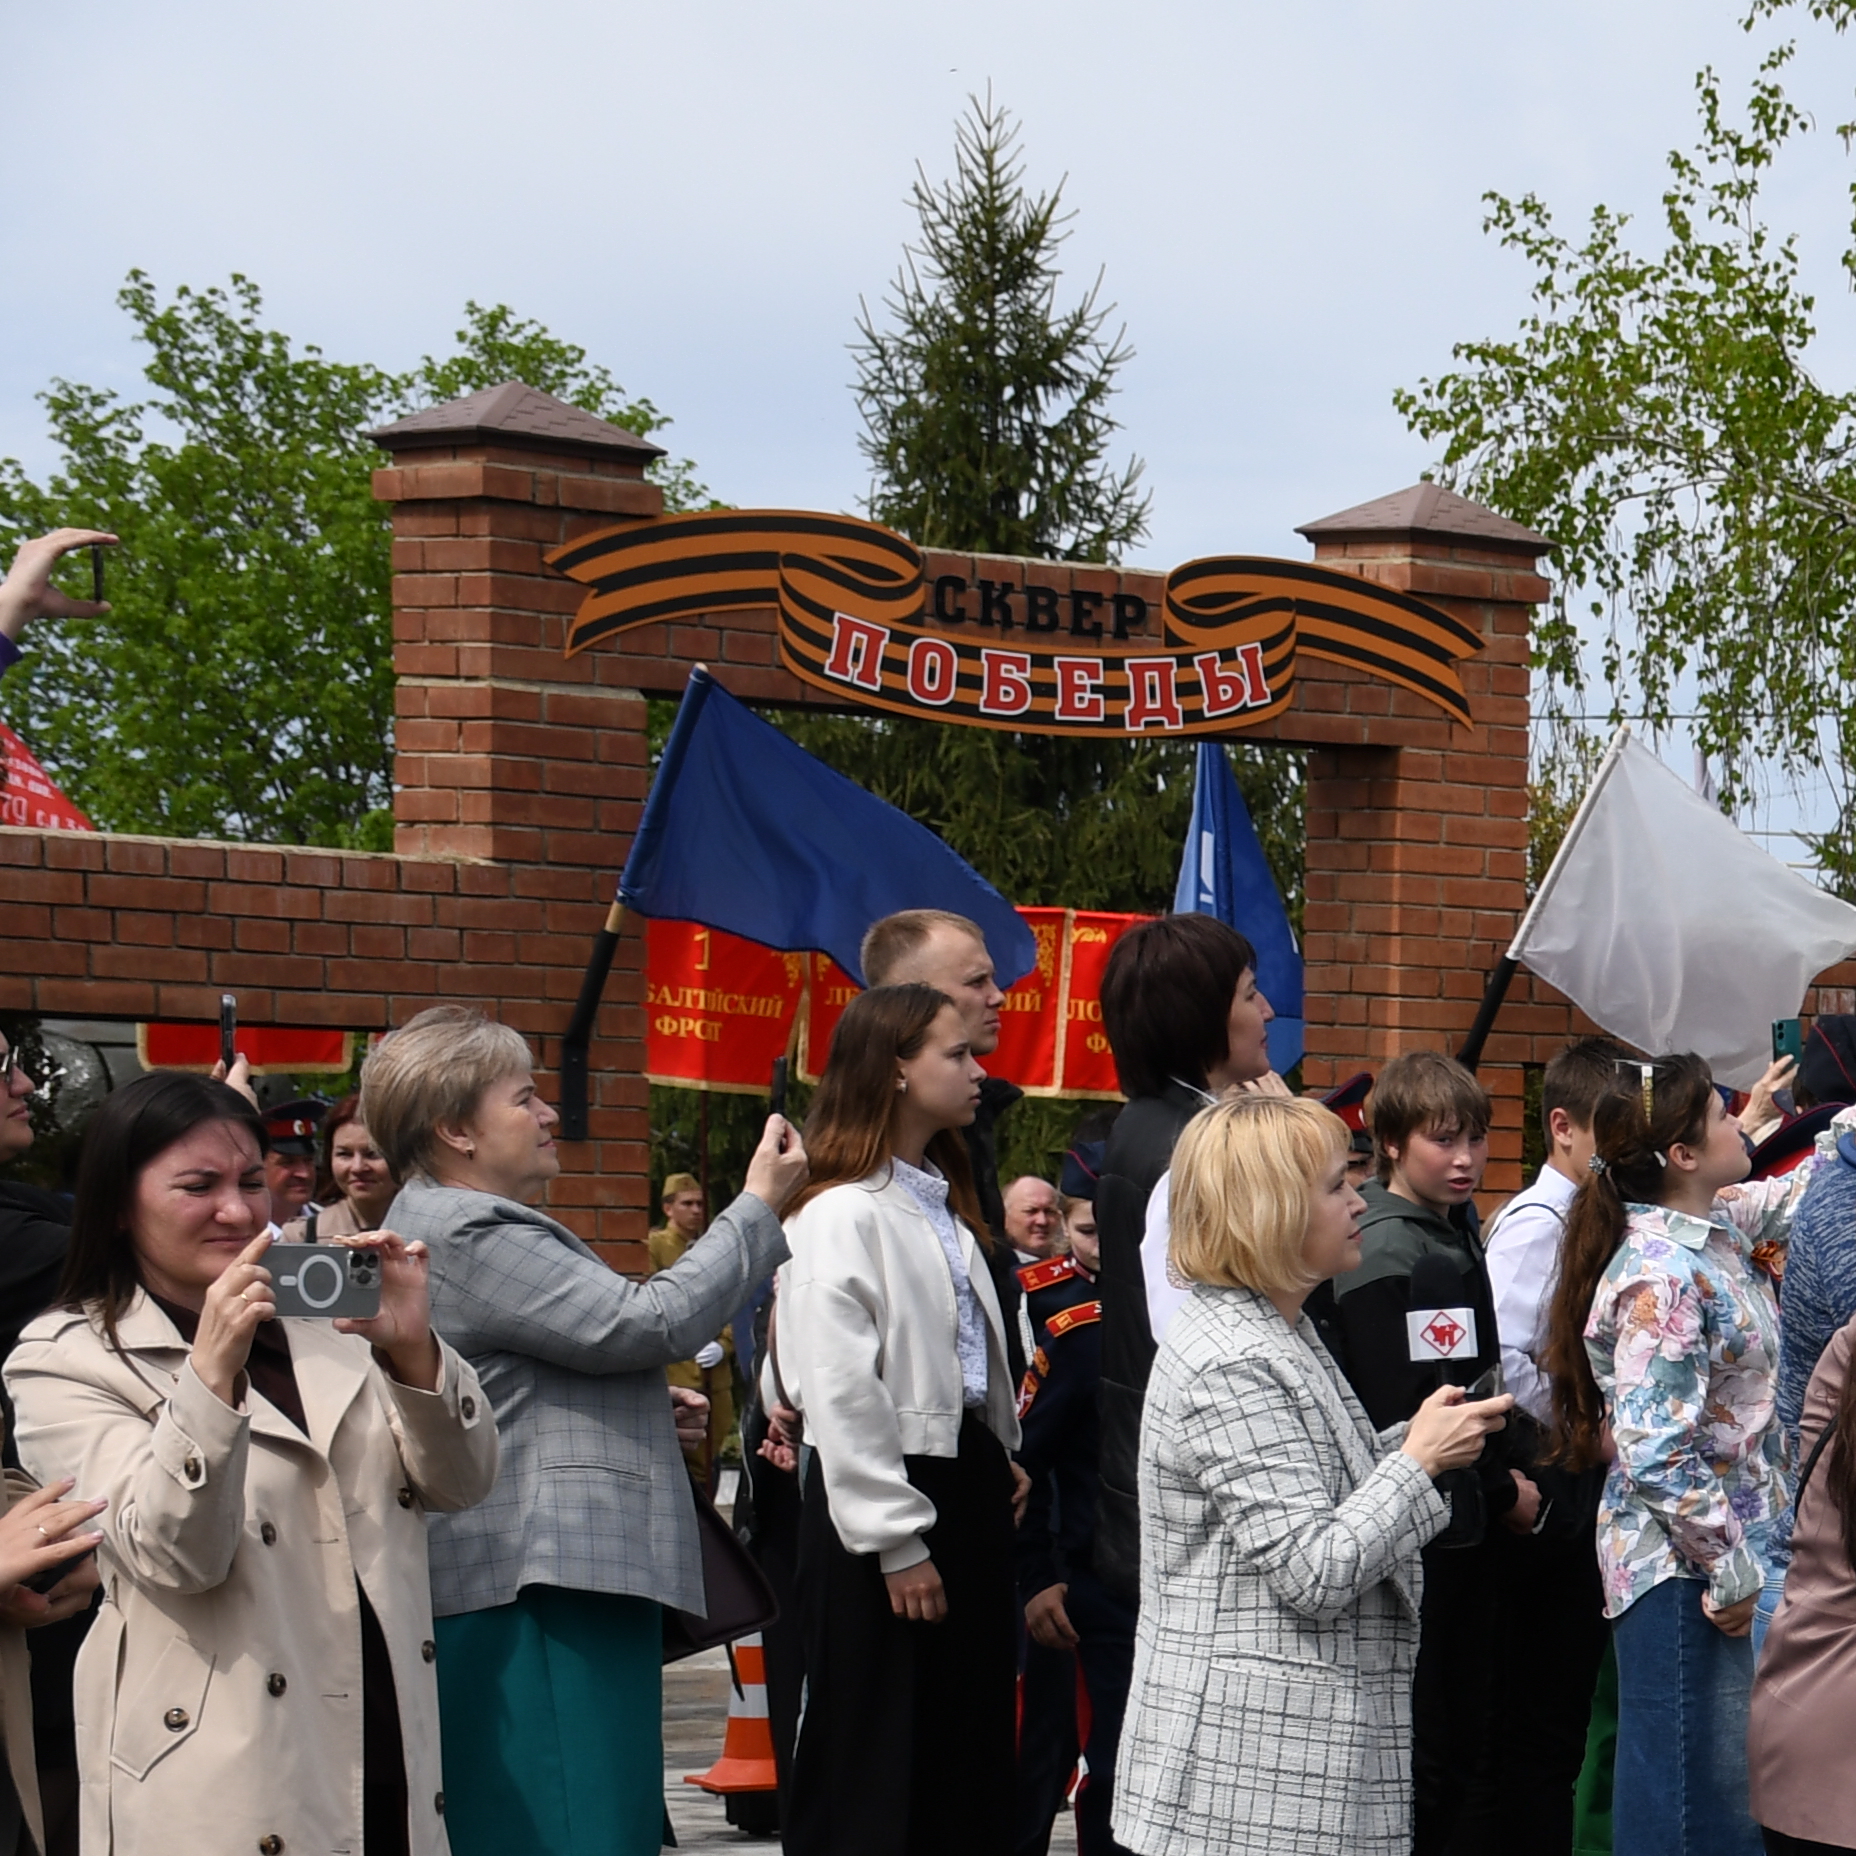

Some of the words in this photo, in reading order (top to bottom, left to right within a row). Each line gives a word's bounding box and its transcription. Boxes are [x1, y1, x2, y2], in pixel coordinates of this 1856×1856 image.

[934, 574, 1149, 639] СКВЕР
[824, 611, 1271, 731] ПОБЕДЫ
[694, 930, 711, 970] 1
